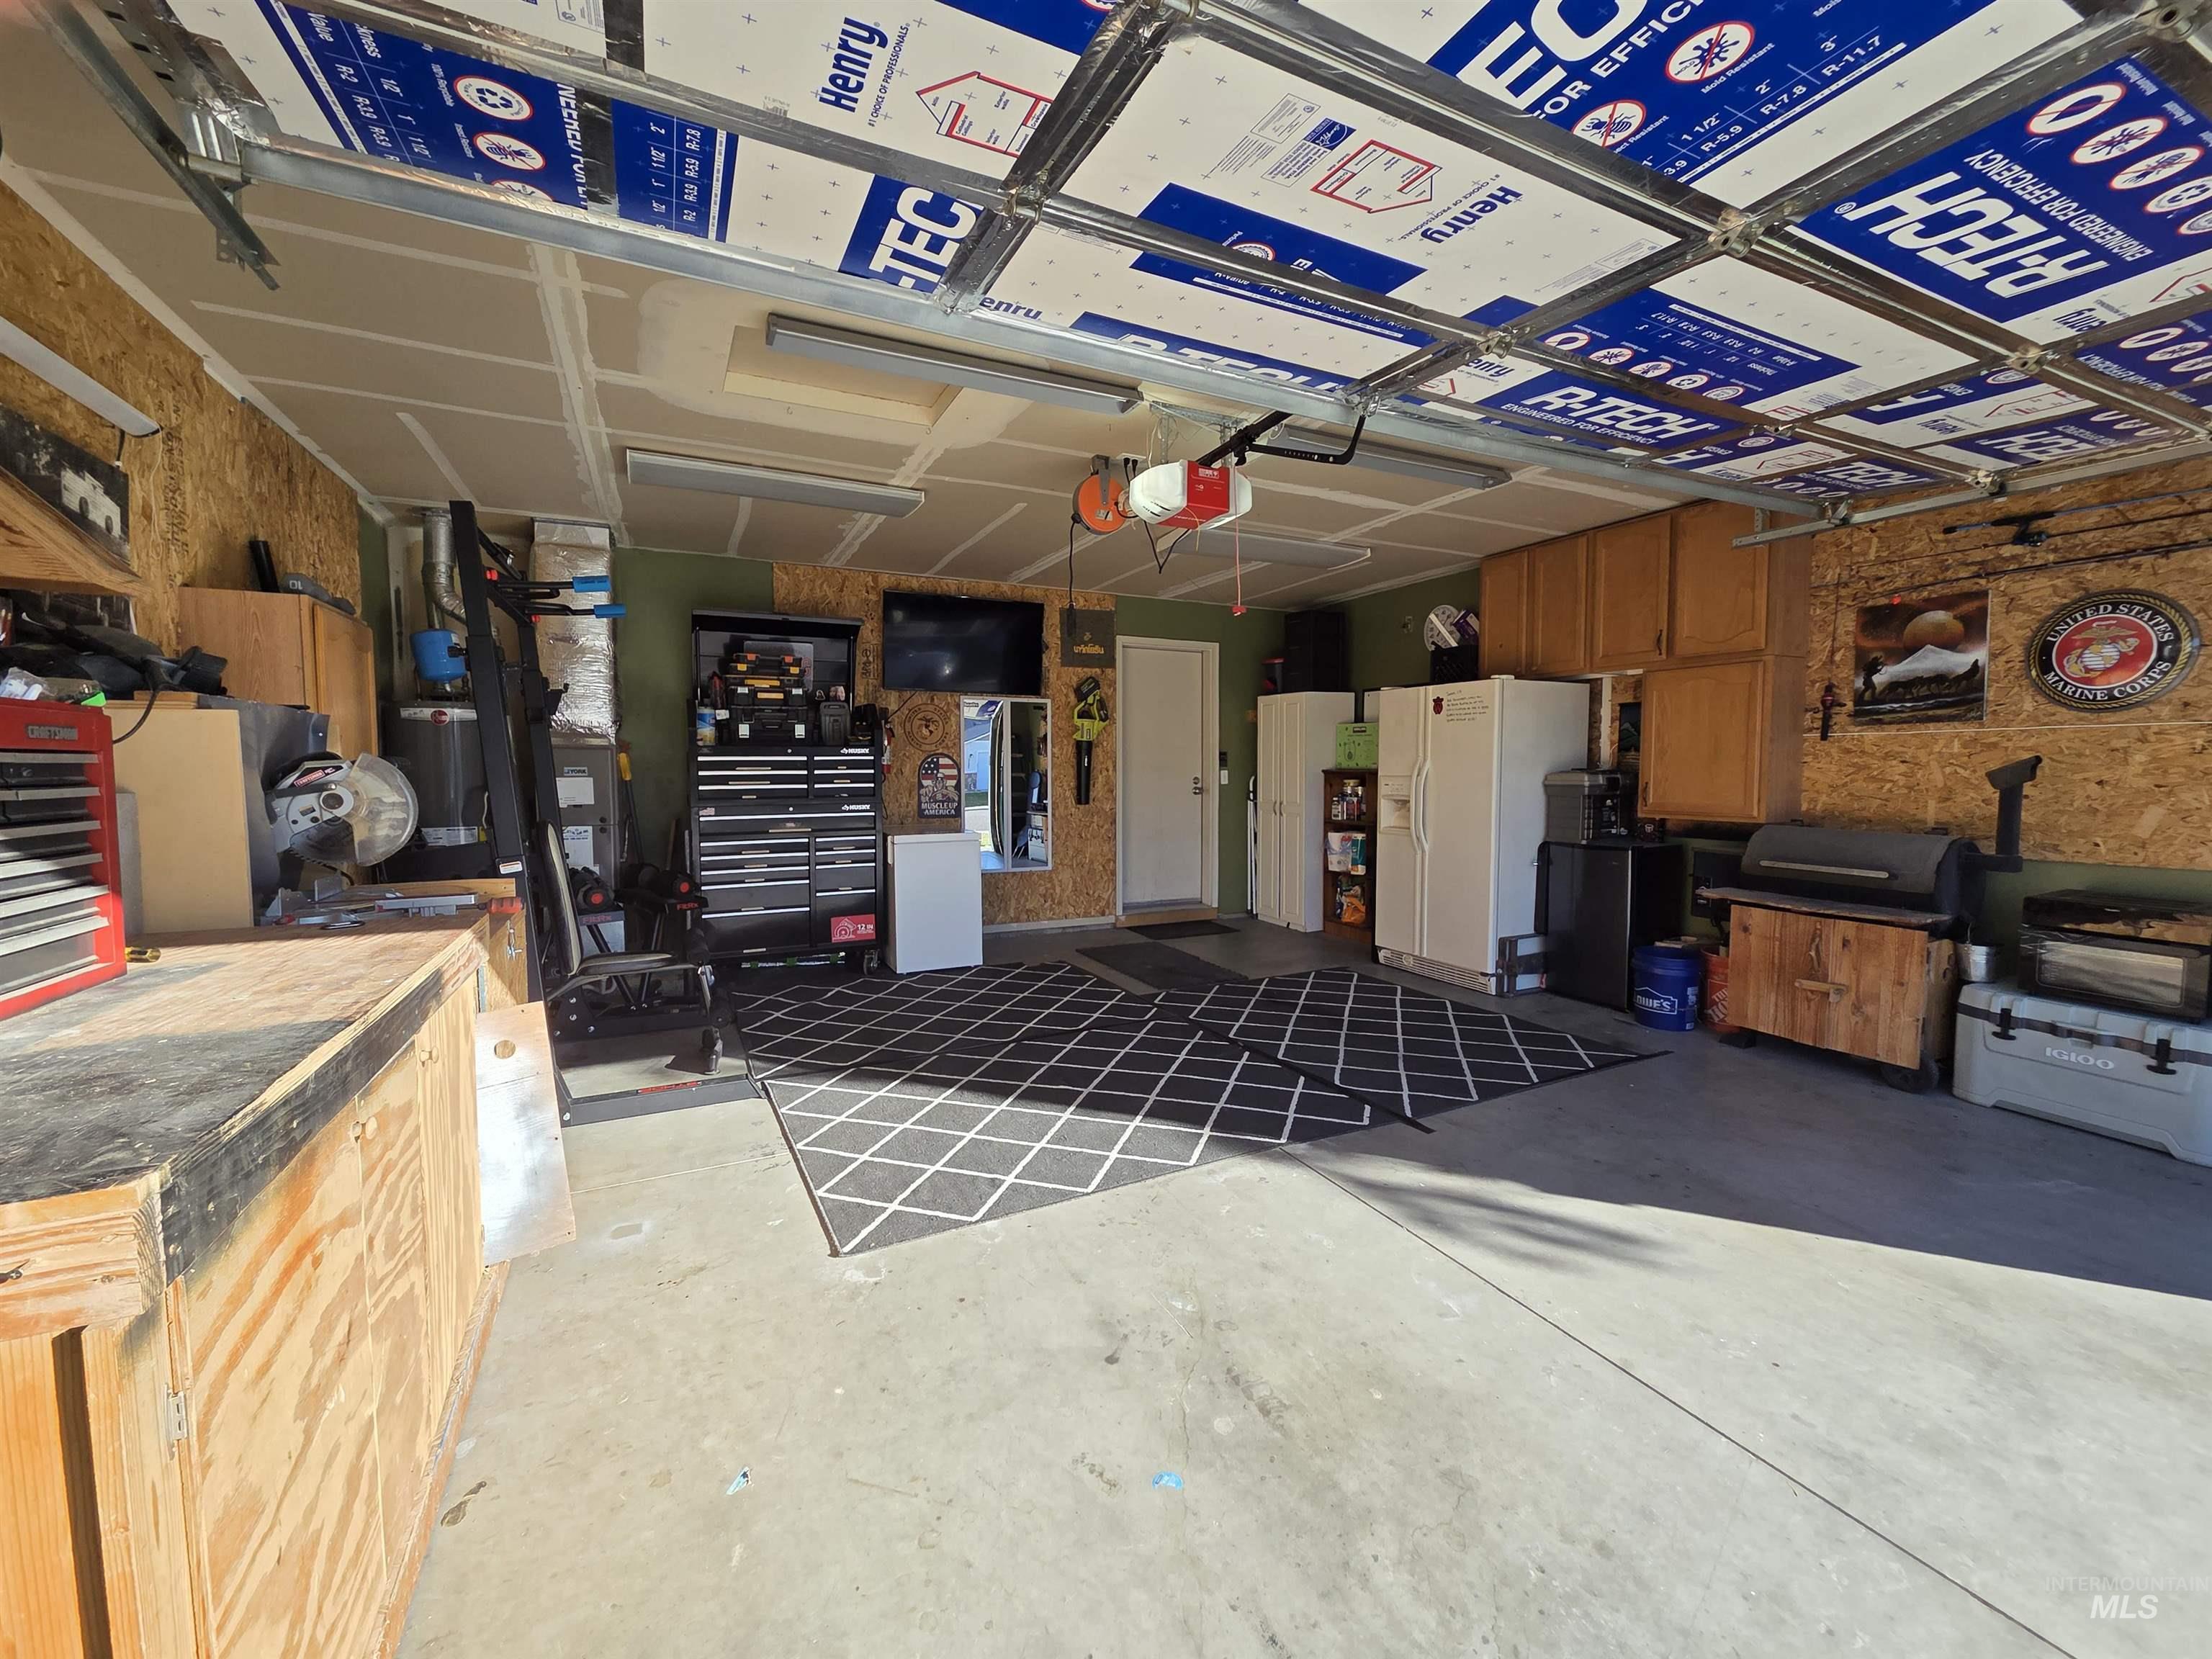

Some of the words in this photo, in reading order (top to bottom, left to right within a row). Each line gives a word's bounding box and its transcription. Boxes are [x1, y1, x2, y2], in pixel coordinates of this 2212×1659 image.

[335, 63, 359, 83] R-2
[819, 17, 889, 113] Henry
[871, 94, 886, 119] CHOICE
[883, 24, 910, 84] PROFESSIONALS
[1701, 78, 1726, 95] Mold
[1727, 42, 1776, 76] Resistant
[1700, 125, 1743, 153] R-5.9
[1759, 85, 1807, 117] R-7.8
[1821, 35, 1881, 76] R-11.7
[685, 128, 701, 151] R-7.8
[1627, 114, 1671, 145] Resistant
[685, 158, 699, 179] R-5.9
[1964, 148, 2061, 207] EFFICIENCY
[684, 183, 698, 202] R-3.9
[1461, 180, 1491, 201] CHOICE
[2041, 188, 2077, 221] FOR
[683, 209, 697, 222] R-2
[1400, 205, 1455, 240] PROFESSIONALS
[1420, 185, 1523, 243] Henry
[2067, 207, 2154, 261] ENGINEERED
[1842, 172, 2110, 298] R-TECH
[1501, 403, 1575, 429] ENGINEERED
[1573, 419, 1597, 434] FOR
[1596, 424, 1659, 446] EFFICIENCY
[1521, 386, 1714, 441] R-TECH
[2047, 603, 2112, 643] UNITED
[2118, 603, 2176, 643] STATES
[2043, 670, 2109, 702] MARINE
[2113, 660, 2172, 700] CORPS
[2045, 1046, 2115, 1070] IGLOO
